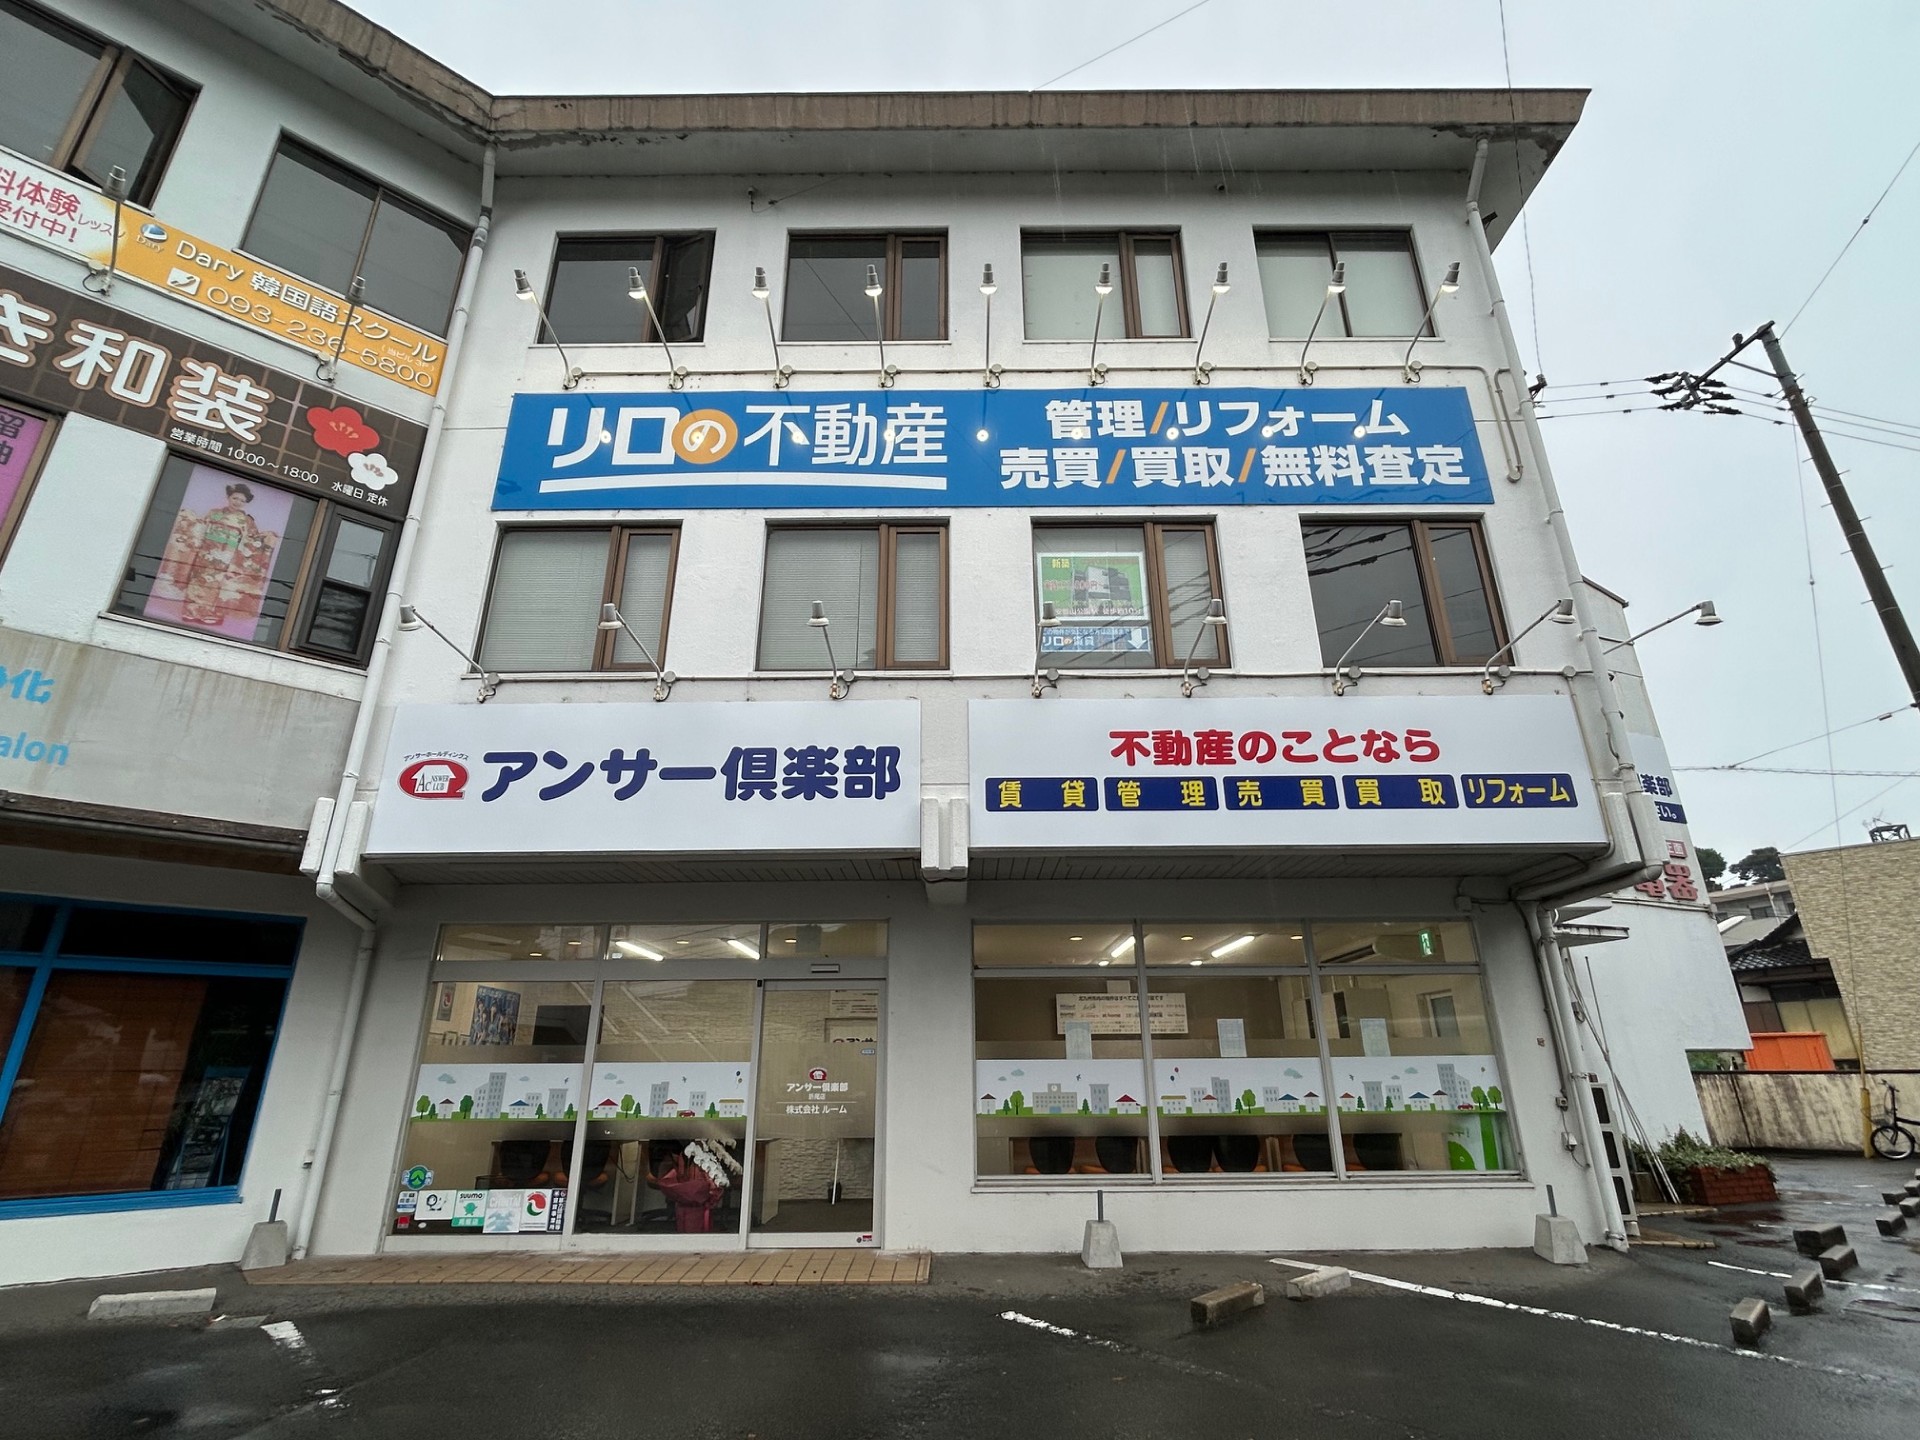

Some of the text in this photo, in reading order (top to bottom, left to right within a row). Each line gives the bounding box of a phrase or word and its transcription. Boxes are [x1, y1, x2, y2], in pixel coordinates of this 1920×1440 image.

[136, 234, 164, 253] Dary
[176, 239, 438, 362] Dary 韓国語スクール
[206, 285, 433, 388] 093-236-5800
[0, 292, 272, 442] き和装
[169, 426, 223, 454] 営業時間
[546, 401, 949, 470] リロの不動産
[331, 481, 389, 507] 水曜日 定休
[1109, 728, 1441, 767] 不動産のことなら
[481, 745, 901, 802] アンサー倶楽部
[1636, 773, 1673, 798] 楽部
[998, 778, 1570, 808] 賃貸 管理 売買 買取 リフォーム
[786, 1104, 848, 1114] 株式会社 ルーム
